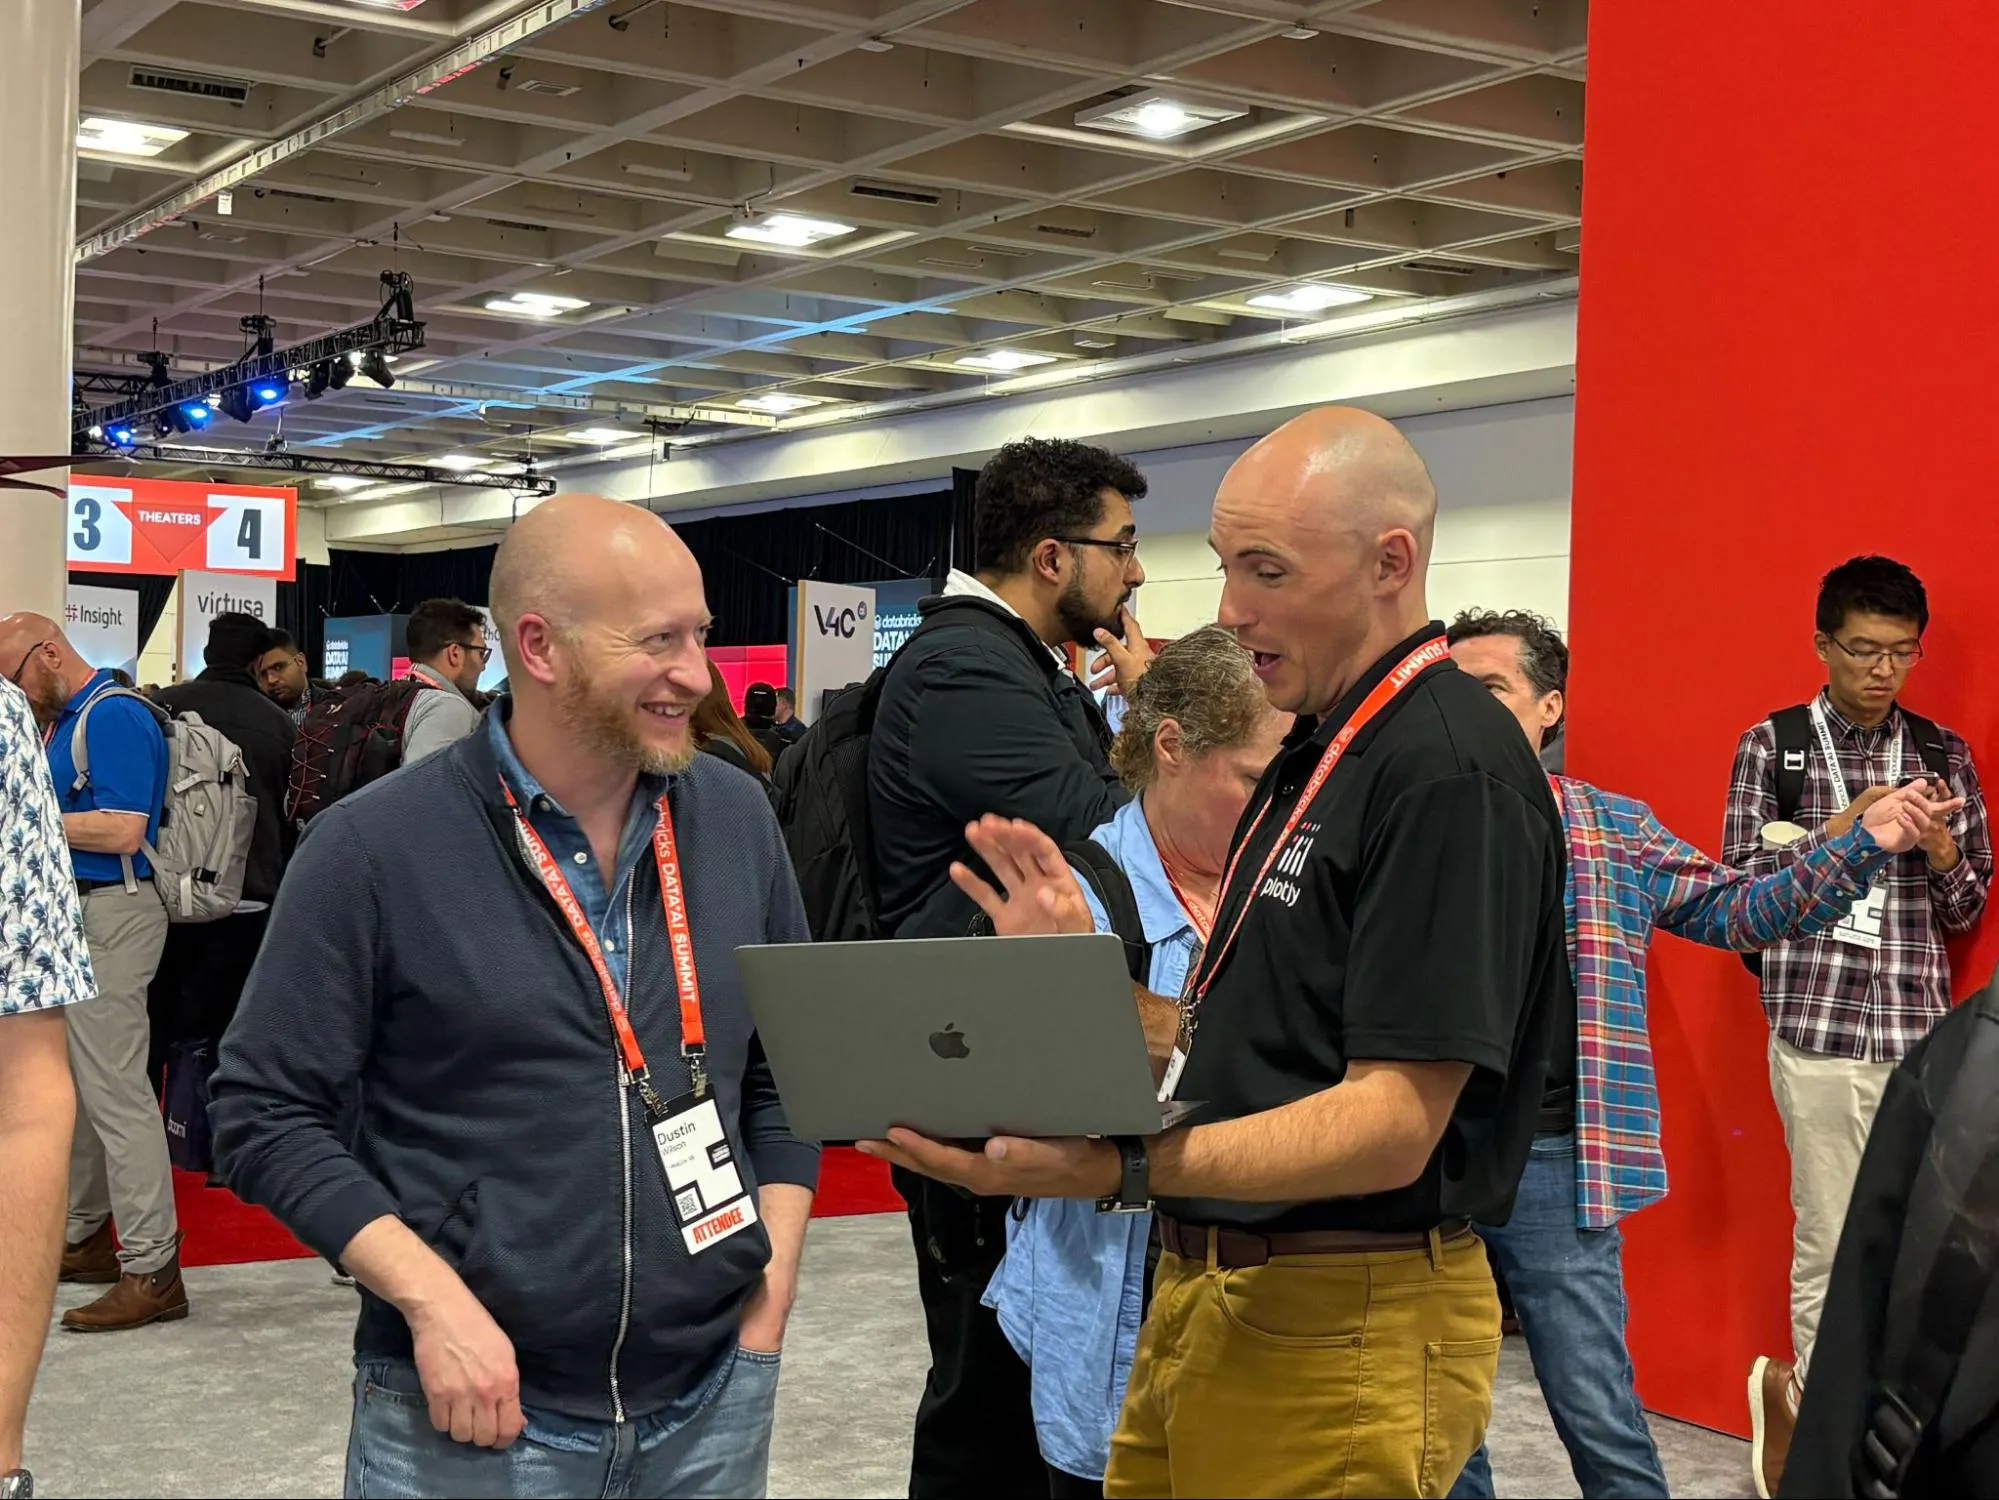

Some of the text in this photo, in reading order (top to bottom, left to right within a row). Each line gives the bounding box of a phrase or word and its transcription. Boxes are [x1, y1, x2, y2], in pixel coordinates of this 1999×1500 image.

[73, 498, 101, 551] 3
[138, 509, 201, 526] THEATERS
[237, 508, 262, 559] 4
[80, 604, 122, 629] Insight
[197, 592, 264, 618] virtusa
[814, 604, 856, 638] V4C
[1390, 642, 1443, 688] SUMMIT
[1260, 876, 1301, 908] plotly
[674, 932, 696, 1003] SUMMIT
[657, 1121, 697, 1146] Dustin
[692, 1206, 744, 1245] ATTENDEE
